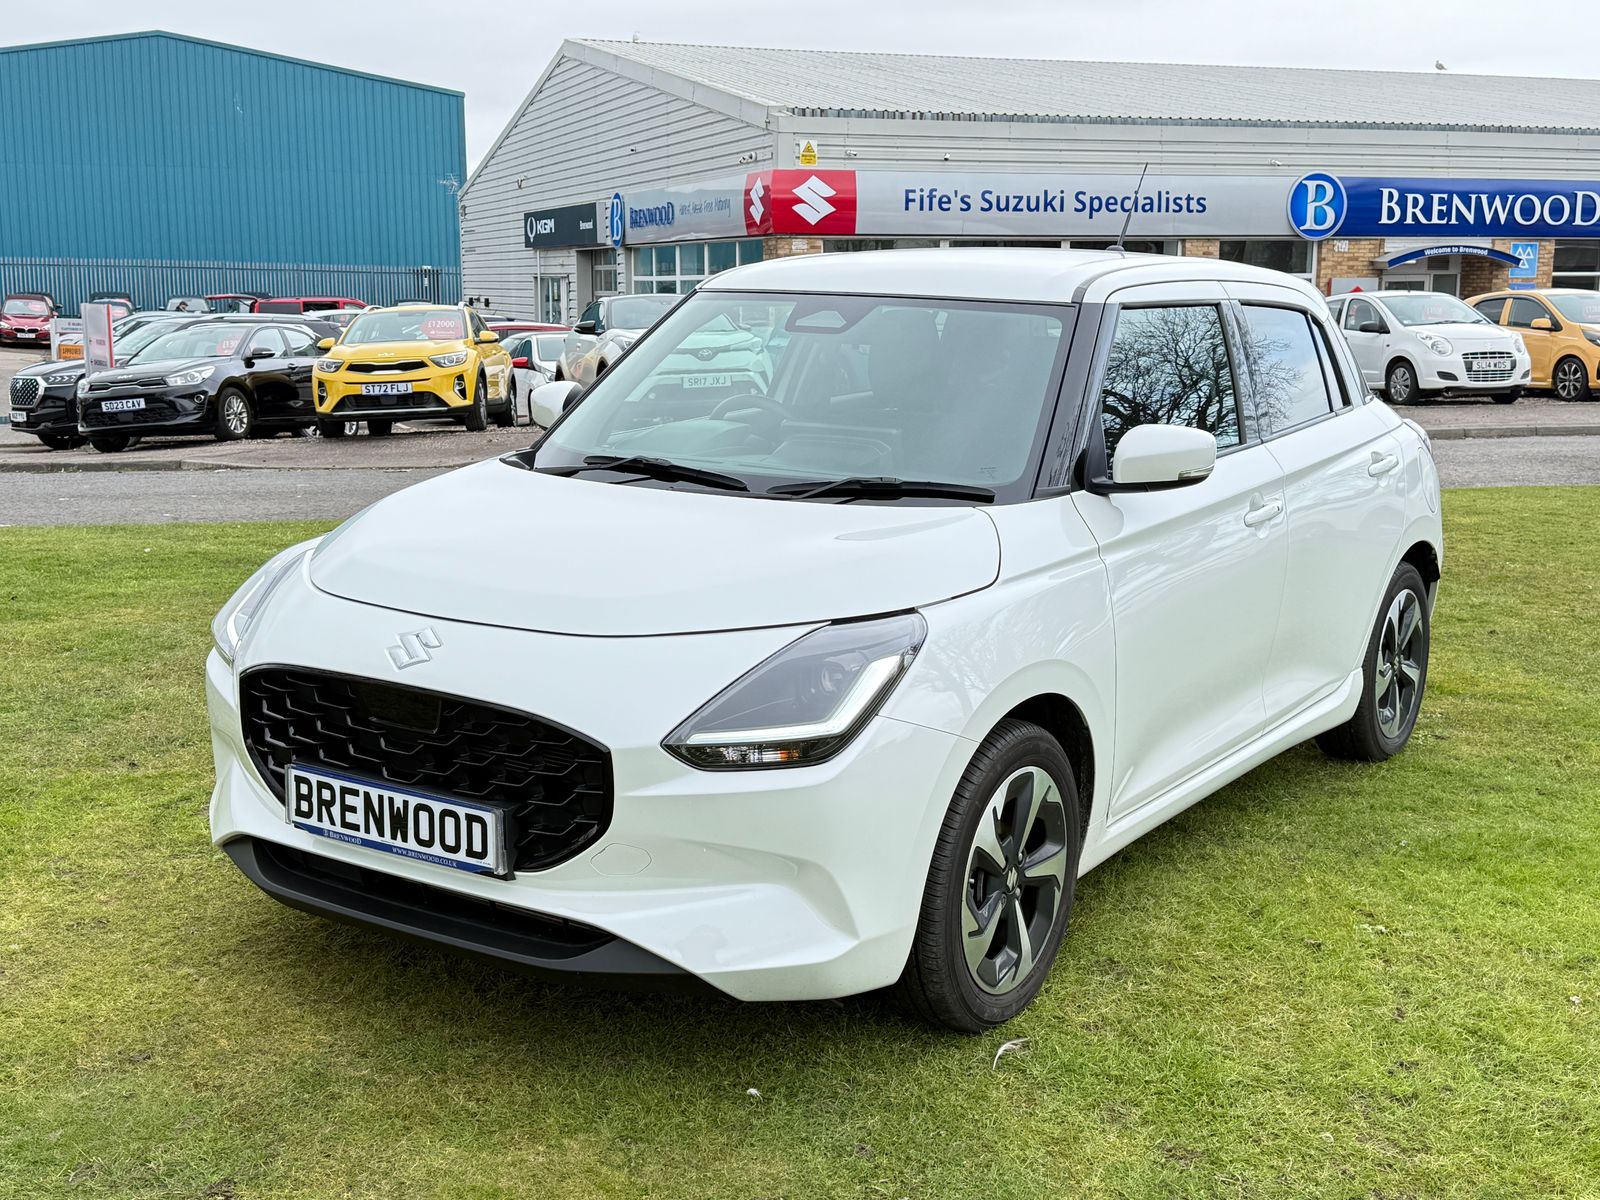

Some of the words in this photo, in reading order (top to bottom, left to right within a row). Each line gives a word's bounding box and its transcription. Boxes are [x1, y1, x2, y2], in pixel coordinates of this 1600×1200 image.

[903, 188, 972, 212] Fife's
[979, 189, 1066, 213] Suzuki
[1073, 190, 1207, 219] Specialists
[1378, 187, 1600, 226] BRENWOOD
[629, 201, 675, 229] BRENWOOD
[536, 218, 555, 234] KGM
[1424, 247, 1451, 256] Welcome
[1459, 246, 1488, 256] Brenwood
[428, 320, 455, 328] £12000
[364, 384, 390, 394] ST72
[390, 383, 409, 393] FLJ
[687, 377, 707, 387] SR17
[710, 376, 726, 386] JXJ
[125, 399, 141, 409] CAV
[294, 775, 488, 861] BRENWOOD
[329, 830, 362, 845] BRENWOOD
